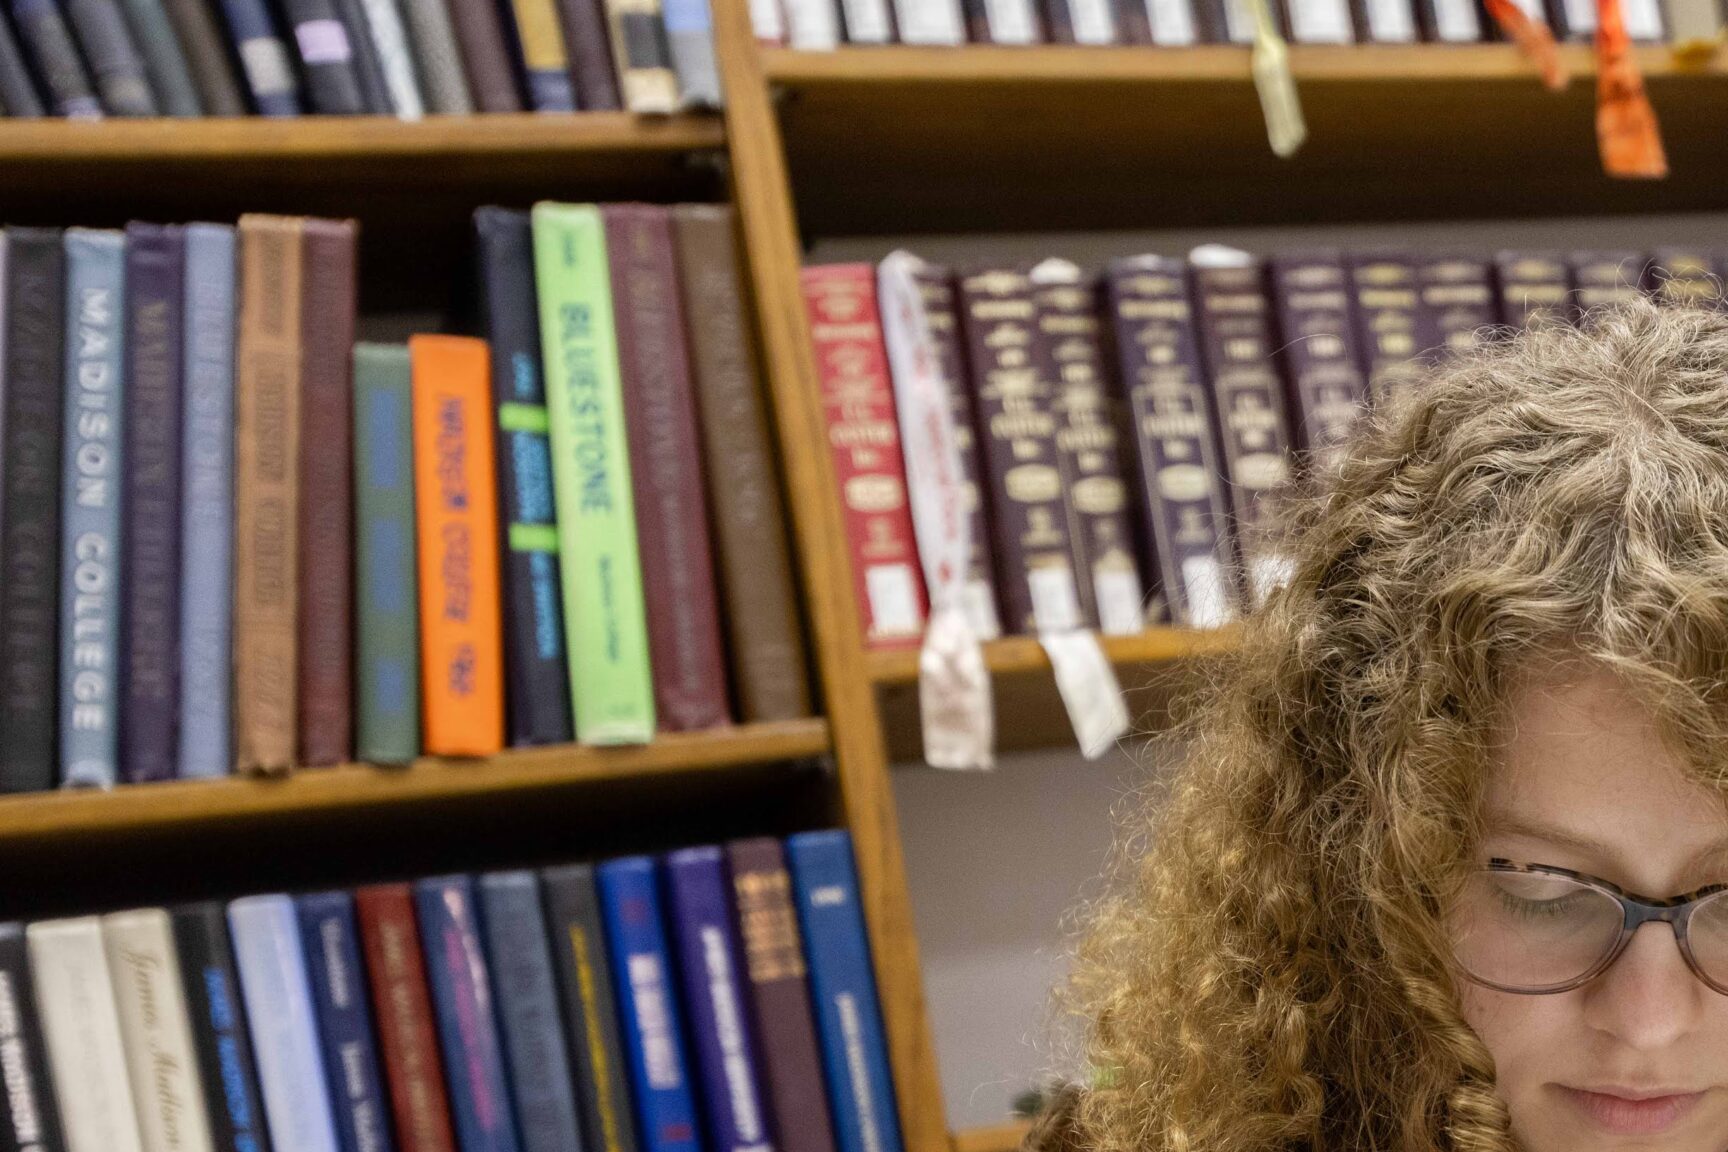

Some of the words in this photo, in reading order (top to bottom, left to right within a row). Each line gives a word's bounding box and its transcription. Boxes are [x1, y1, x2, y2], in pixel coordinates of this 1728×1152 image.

[79, 288, 107, 506] MADISON
[559, 302, 611, 516] BLUESTONE
[75, 532, 103, 730] COLLEGE
[120, 944, 170, 1031] James
